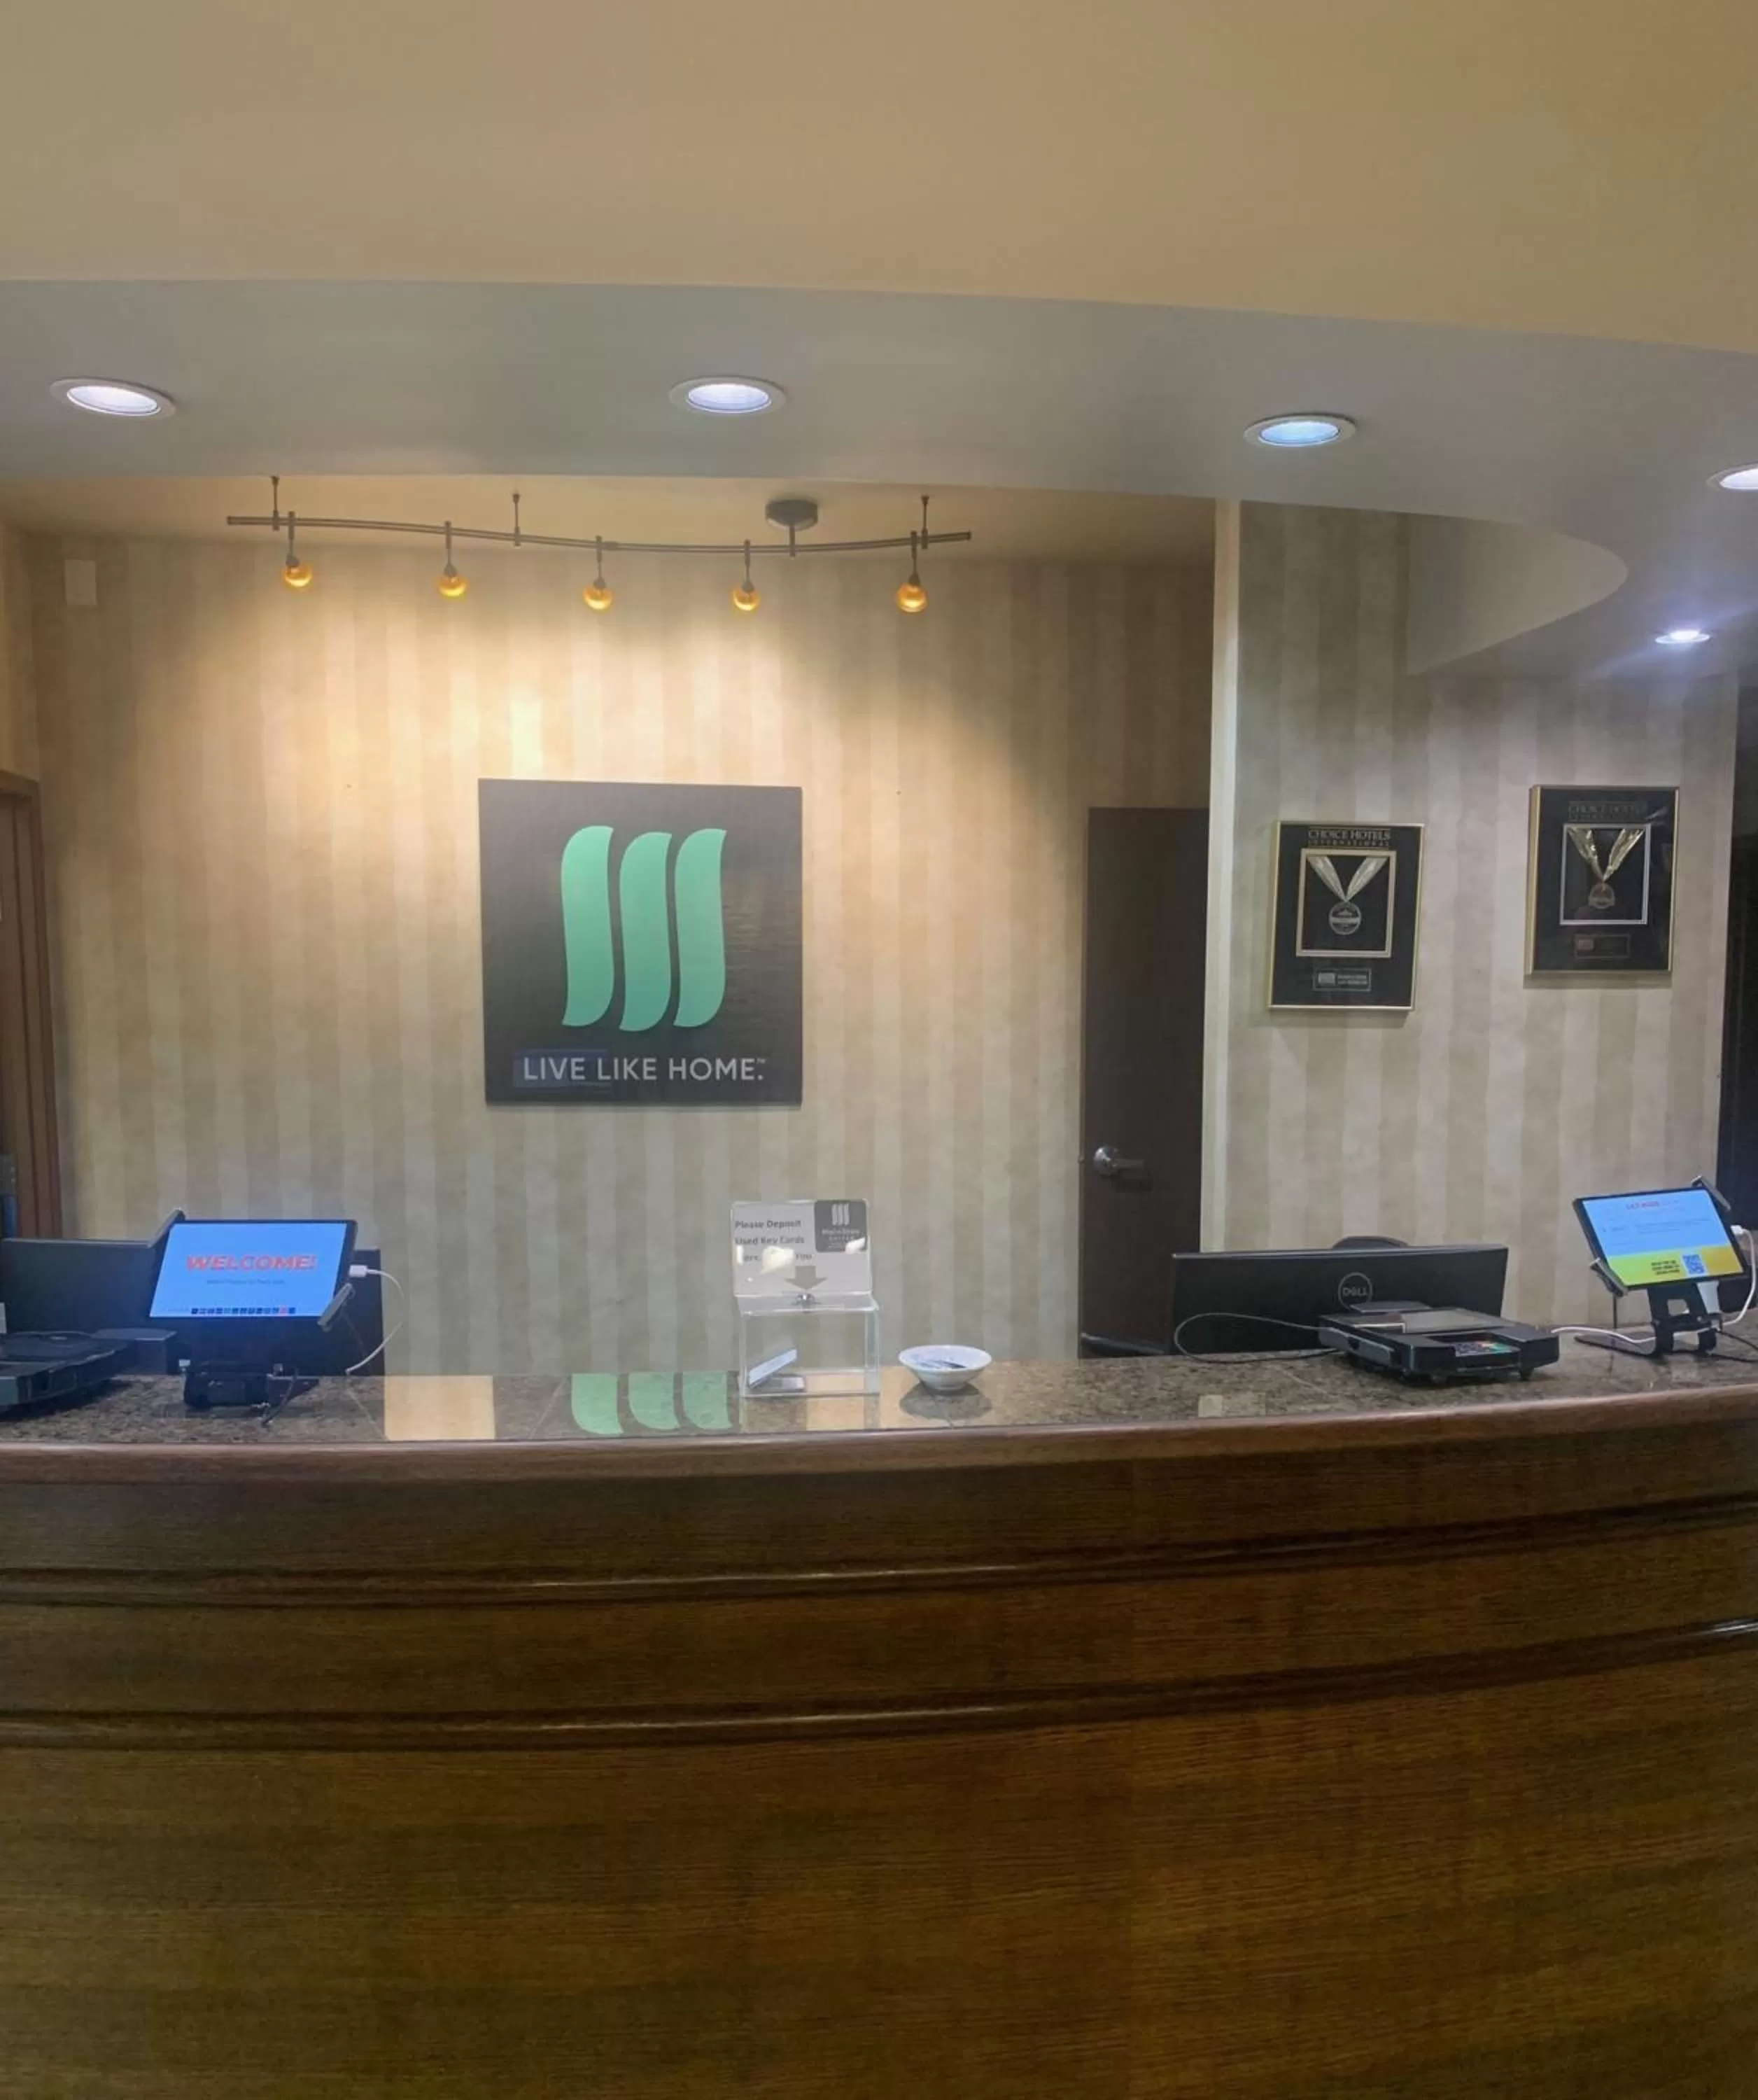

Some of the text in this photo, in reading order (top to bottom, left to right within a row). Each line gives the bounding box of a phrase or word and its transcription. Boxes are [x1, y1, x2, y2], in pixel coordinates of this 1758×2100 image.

[1308, 830, 1391, 840] CHOICE HOTELS
[523, 1057, 586, 1080] LIVE
[597, 1057, 657, 1080] LIKE
[766, 1220, 801, 1229] Deposit
[186, 1254, 318, 1271] WELCOME!
[1342, 1287, 1367, 1297] DELL
